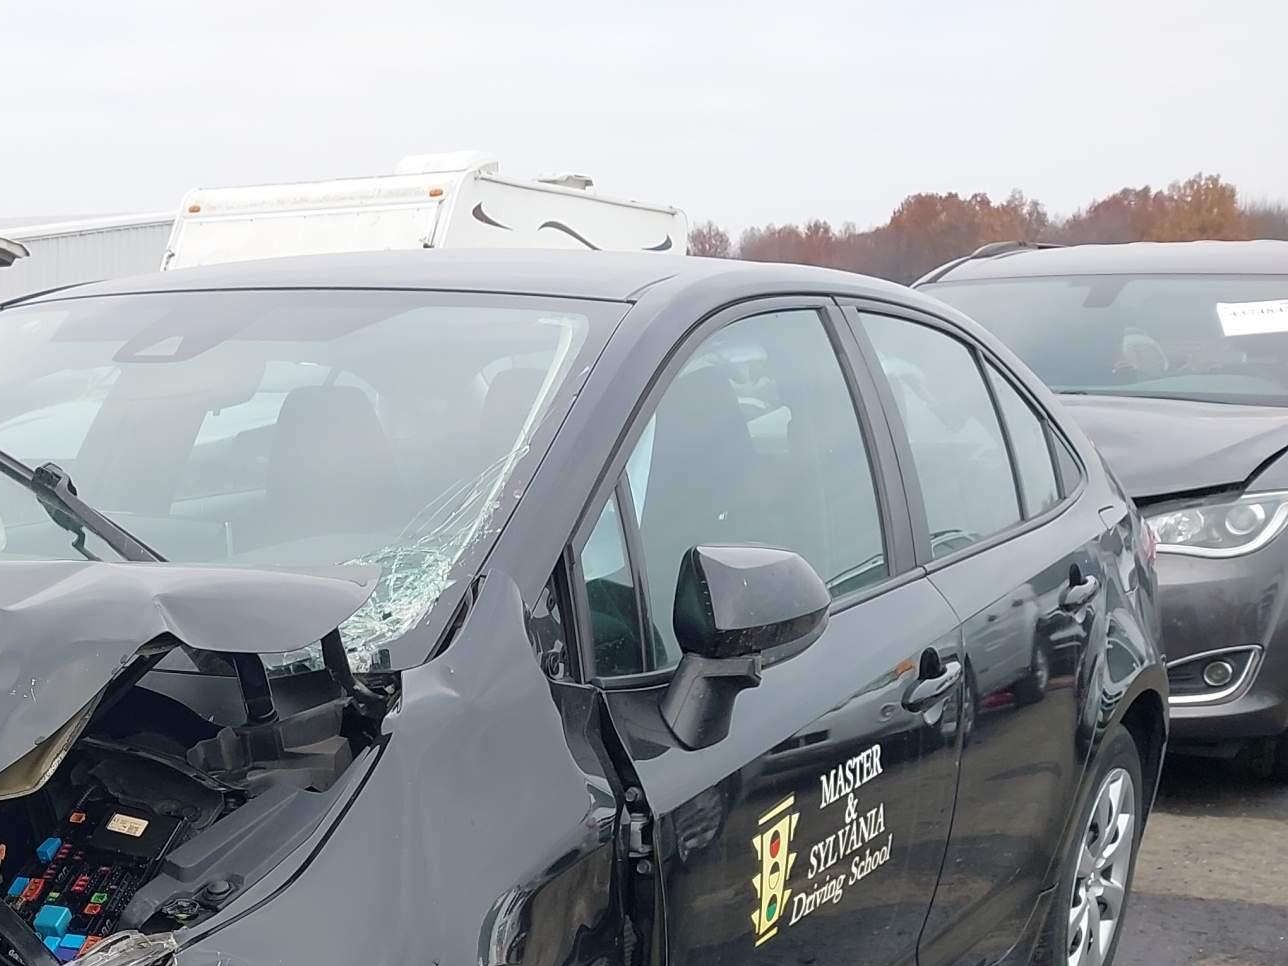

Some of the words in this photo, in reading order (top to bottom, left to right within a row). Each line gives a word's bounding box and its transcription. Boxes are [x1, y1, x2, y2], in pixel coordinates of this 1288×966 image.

[819, 743, 884, 809] MASTER
[845, 792, 859, 824] &
[807, 802, 886, 879] SYLVANIA
[788, 873, 847, 927] Driving
[849, 832, 894, 886] School
